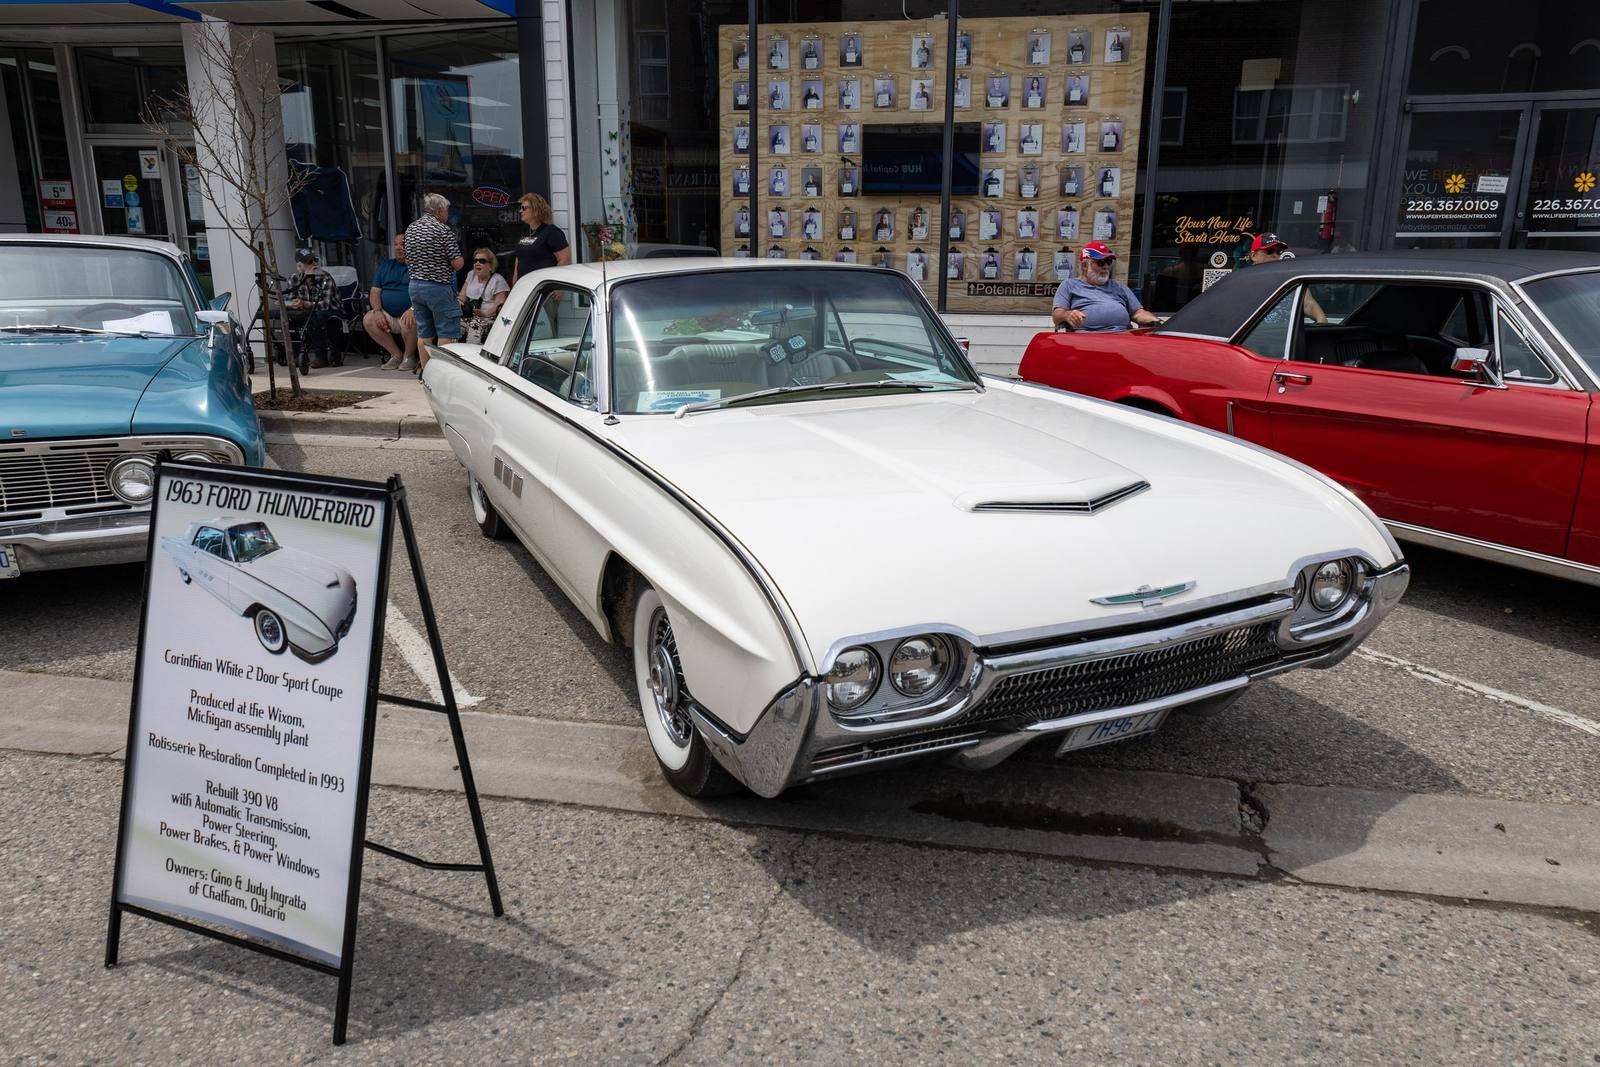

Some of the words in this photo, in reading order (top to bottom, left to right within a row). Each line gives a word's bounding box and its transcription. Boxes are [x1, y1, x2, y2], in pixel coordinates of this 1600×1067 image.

[1406, 200, 1499, 211] 226.367.0109
[1175, 216, 1206, 233] Your
[1206, 216, 1232, 229] New
[1232, 216, 1254, 232] Life
[1175, 230, 1208, 244] Starts
[1208, 230, 1241, 244] Here
[976, 283, 1030, 296] Potential
[166, 480, 204, 504] 1963
[206, 484, 252, 511] FORD
[256, 490, 375, 528] THUNDERBIRD
[164, 649, 212, 672] Corinthian
[216, 658, 244, 678] White
[246, 664, 254, 680] 2
[256, 666, 280, 685] Door
[282, 672, 310, 693] Sport
[312, 678, 343, 702] Coupe
[190, 689, 235, 712] Produced
[237, 701, 247, 715] at
[249, 702, 264, 718] the
[187, 706, 232, 731] Michigan
[234, 720, 281, 746] assembly
[284, 728, 309, 747] plant
[148, 732, 196, 756] Rotisserie
[199, 744, 252, 770] Restoration
[255, 757, 306, 781] Completed
[308, 771, 318, 786] in
[320, 773, 345, 793] 1993
[172, 793, 192, 807] with
[195, 794, 242, 820] Automatic
[206, 780, 239, 801] Rebuilt
[242, 788, 262, 807] 390
[266, 794, 278, 812] V8
[202, 814, 233, 834] Power
[160, 821, 191, 841] Power
[234, 840, 241, 854] &
[244, 842, 273, 863] Power
[276, 851, 320, 878] Windows
[166, 858, 208, 881] Owners:
[211, 868, 232, 888] Gino
[234, 875, 242, 890] &
[245, 878, 268, 902] Judy
[270, 886, 307, 912] Ingratta
[189, 882, 200, 896] of
[250, 897, 286, 922] Ontario
